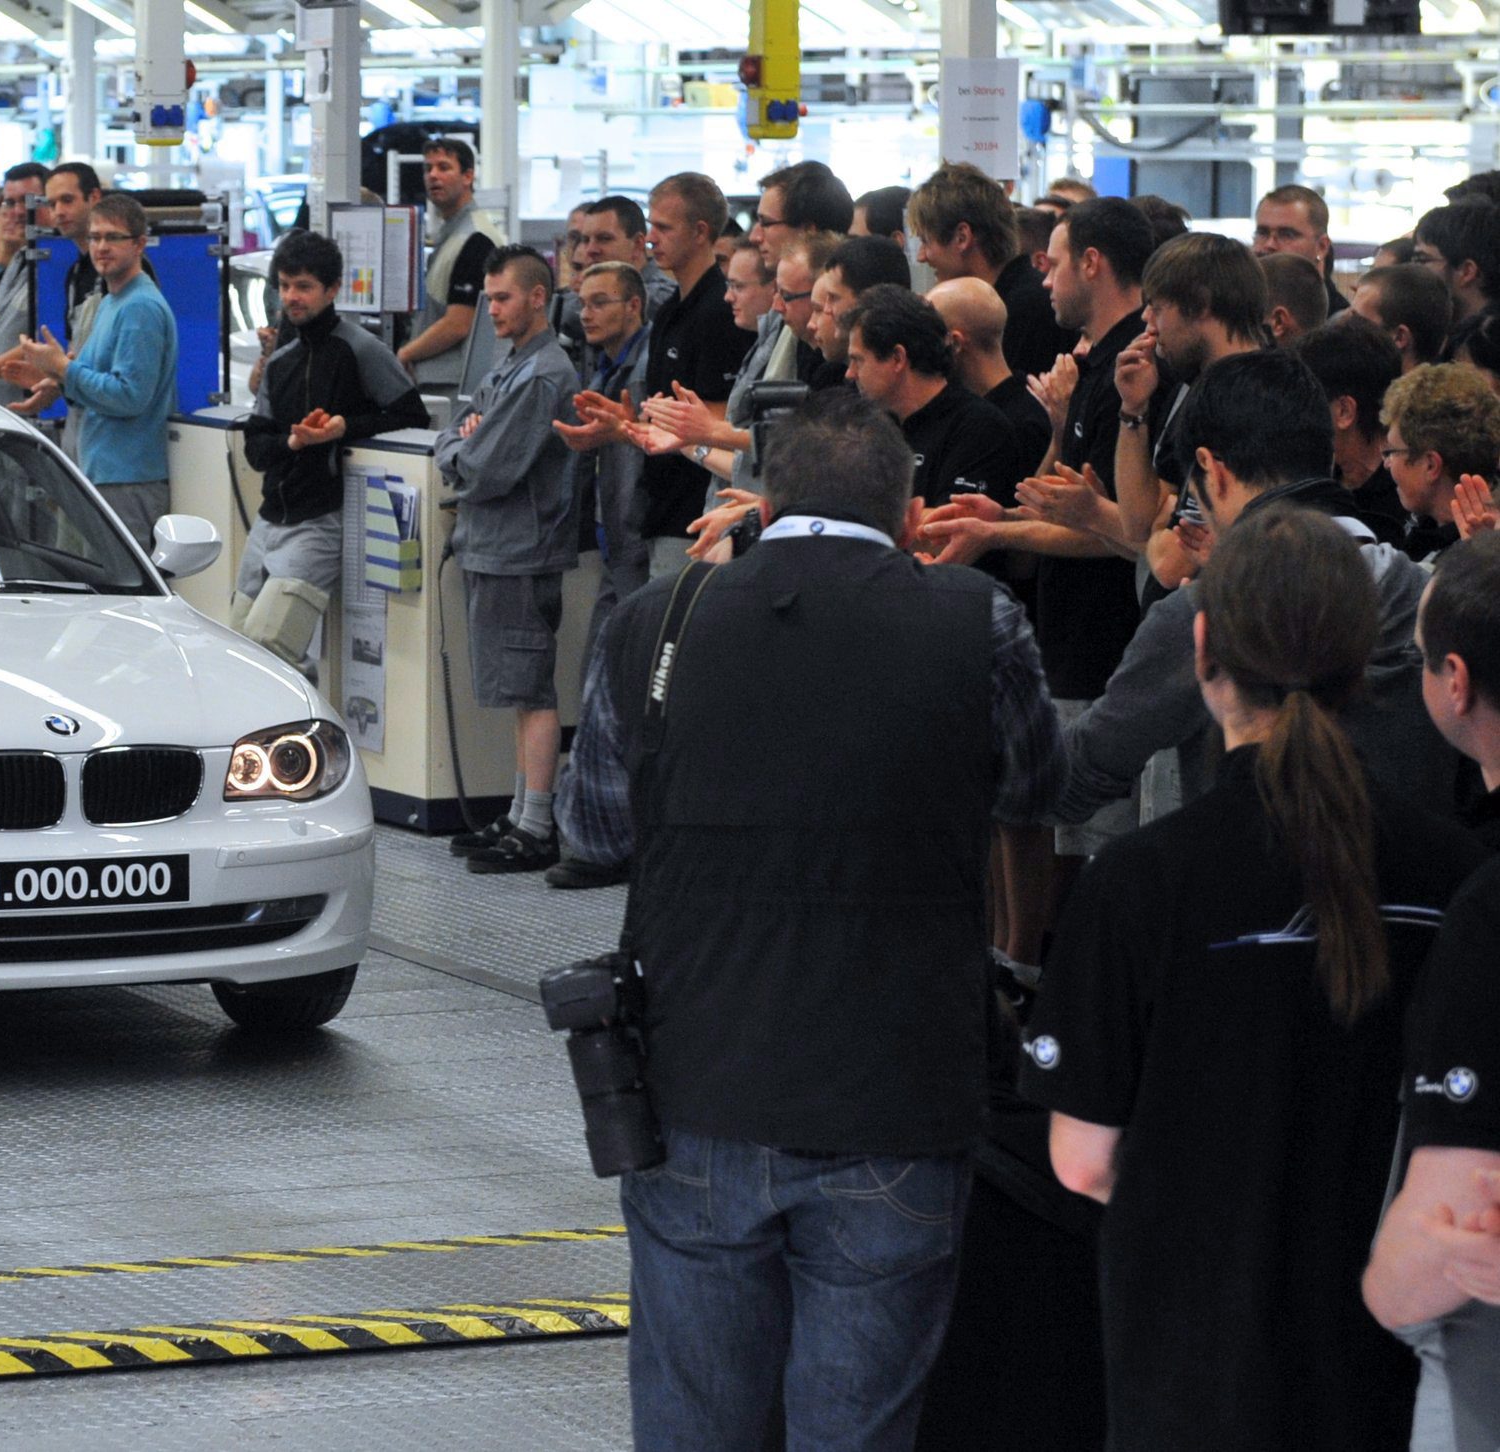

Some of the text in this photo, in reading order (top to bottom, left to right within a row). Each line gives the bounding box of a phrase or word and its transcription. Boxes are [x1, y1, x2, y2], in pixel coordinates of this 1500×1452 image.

[957, 85, 1005, 97] bei Störung
[651, 641, 675, 702] Nikon
